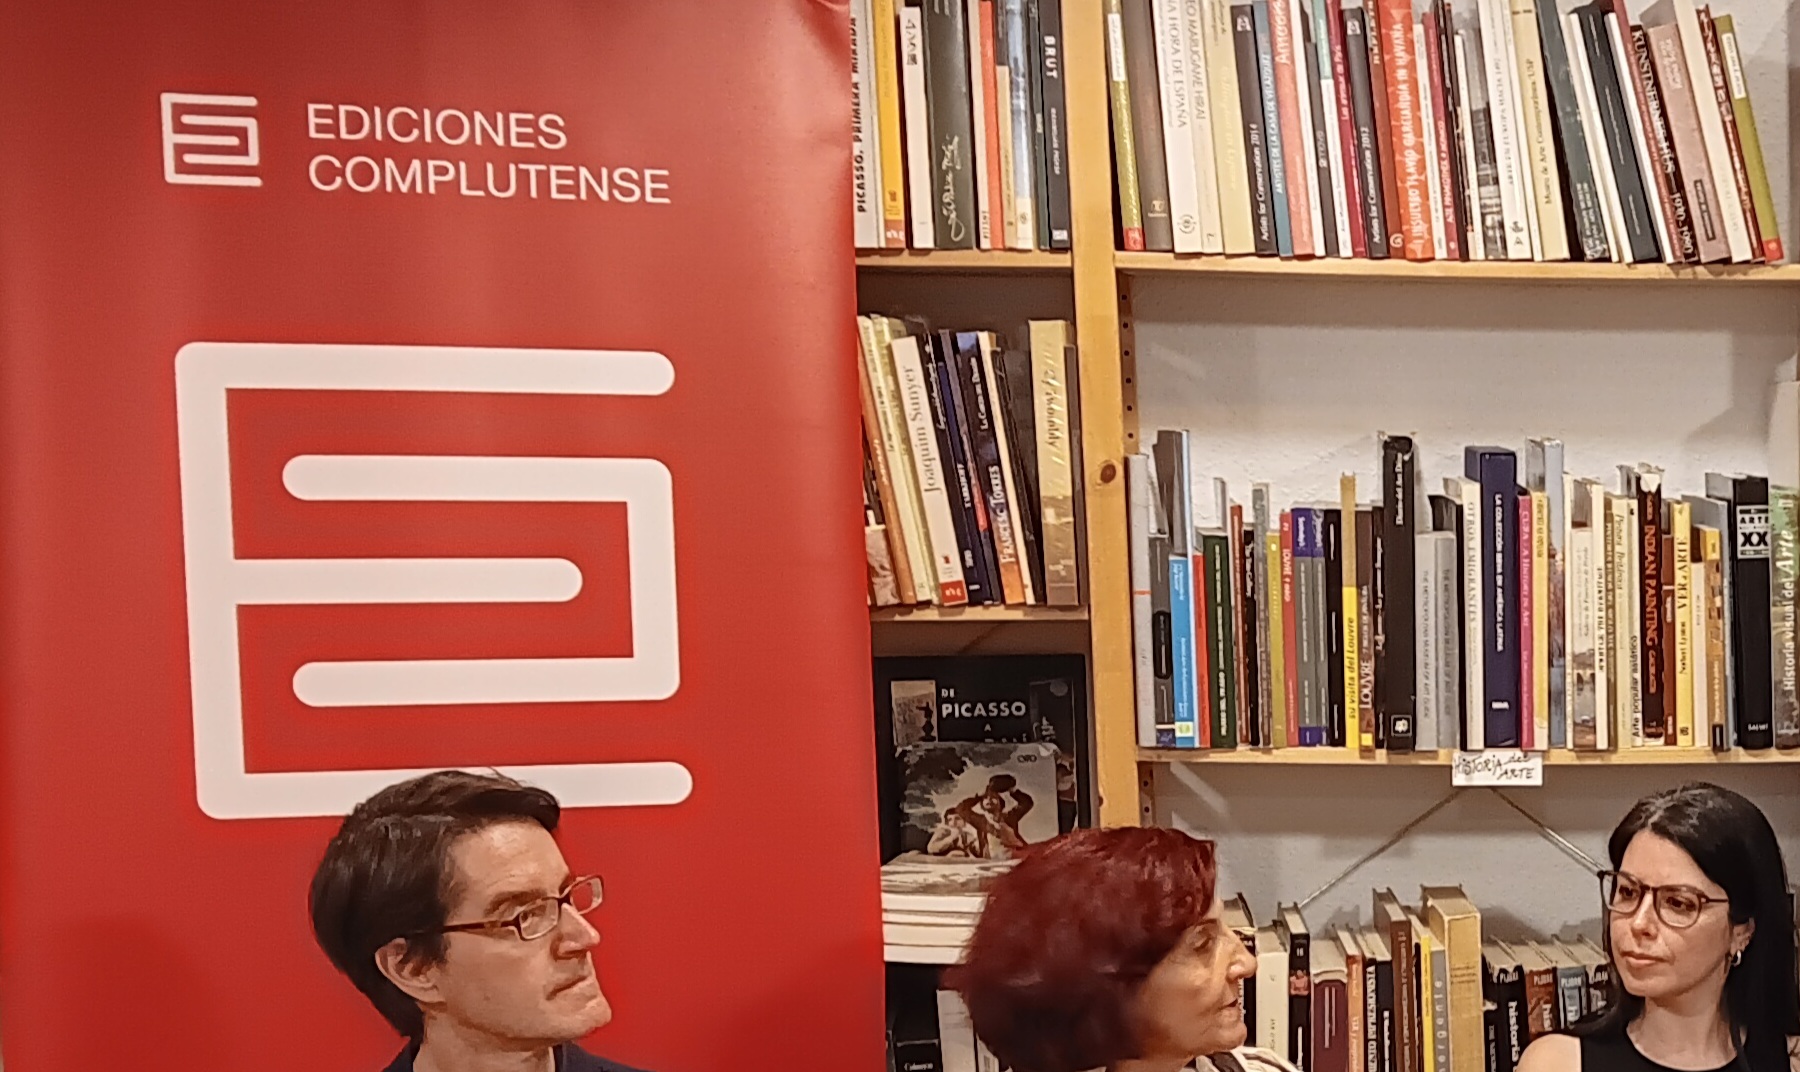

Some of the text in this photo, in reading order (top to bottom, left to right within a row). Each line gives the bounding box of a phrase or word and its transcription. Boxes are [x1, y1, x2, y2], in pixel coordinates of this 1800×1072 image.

[1043, 35, 1057, 78] BRUT
[307, 103, 567, 150] EDICIONES
[308, 154, 671, 204] COMPLUTENSE
[1250, 145, 1267, 201] Conservation
[1358, 124, 1380, 243] Artists for Conservation 2012
[1257, 201, 1266, 214] for
[1259, 215, 1269, 241] Artists
[903, 366, 922, 421] Sunyer
[914, 426, 941, 492] Joaquim
[985, 462, 1016, 563] FRANCESC TORRES
[1465, 501, 1475, 544] OTROS
[1740, 532, 1769, 547] XX
[1642, 524, 1659, 647] INDIAN PAINTING
[1777, 529, 1796, 692] Historia visual del Arte
[1345, 616, 1356, 719] su visita del Louvre
[941, 701, 1027, 719] PICASSO
[1631, 675, 1640, 714] popular
[984, 723, 992, 732] A
[1631, 716, 1640, 737] Arte
[1497, 767, 1534, 781] ARTE
[1364, 963, 1377, 1040] IMPRESIONISTA
[1505, 1000, 1520, 1063] historia
